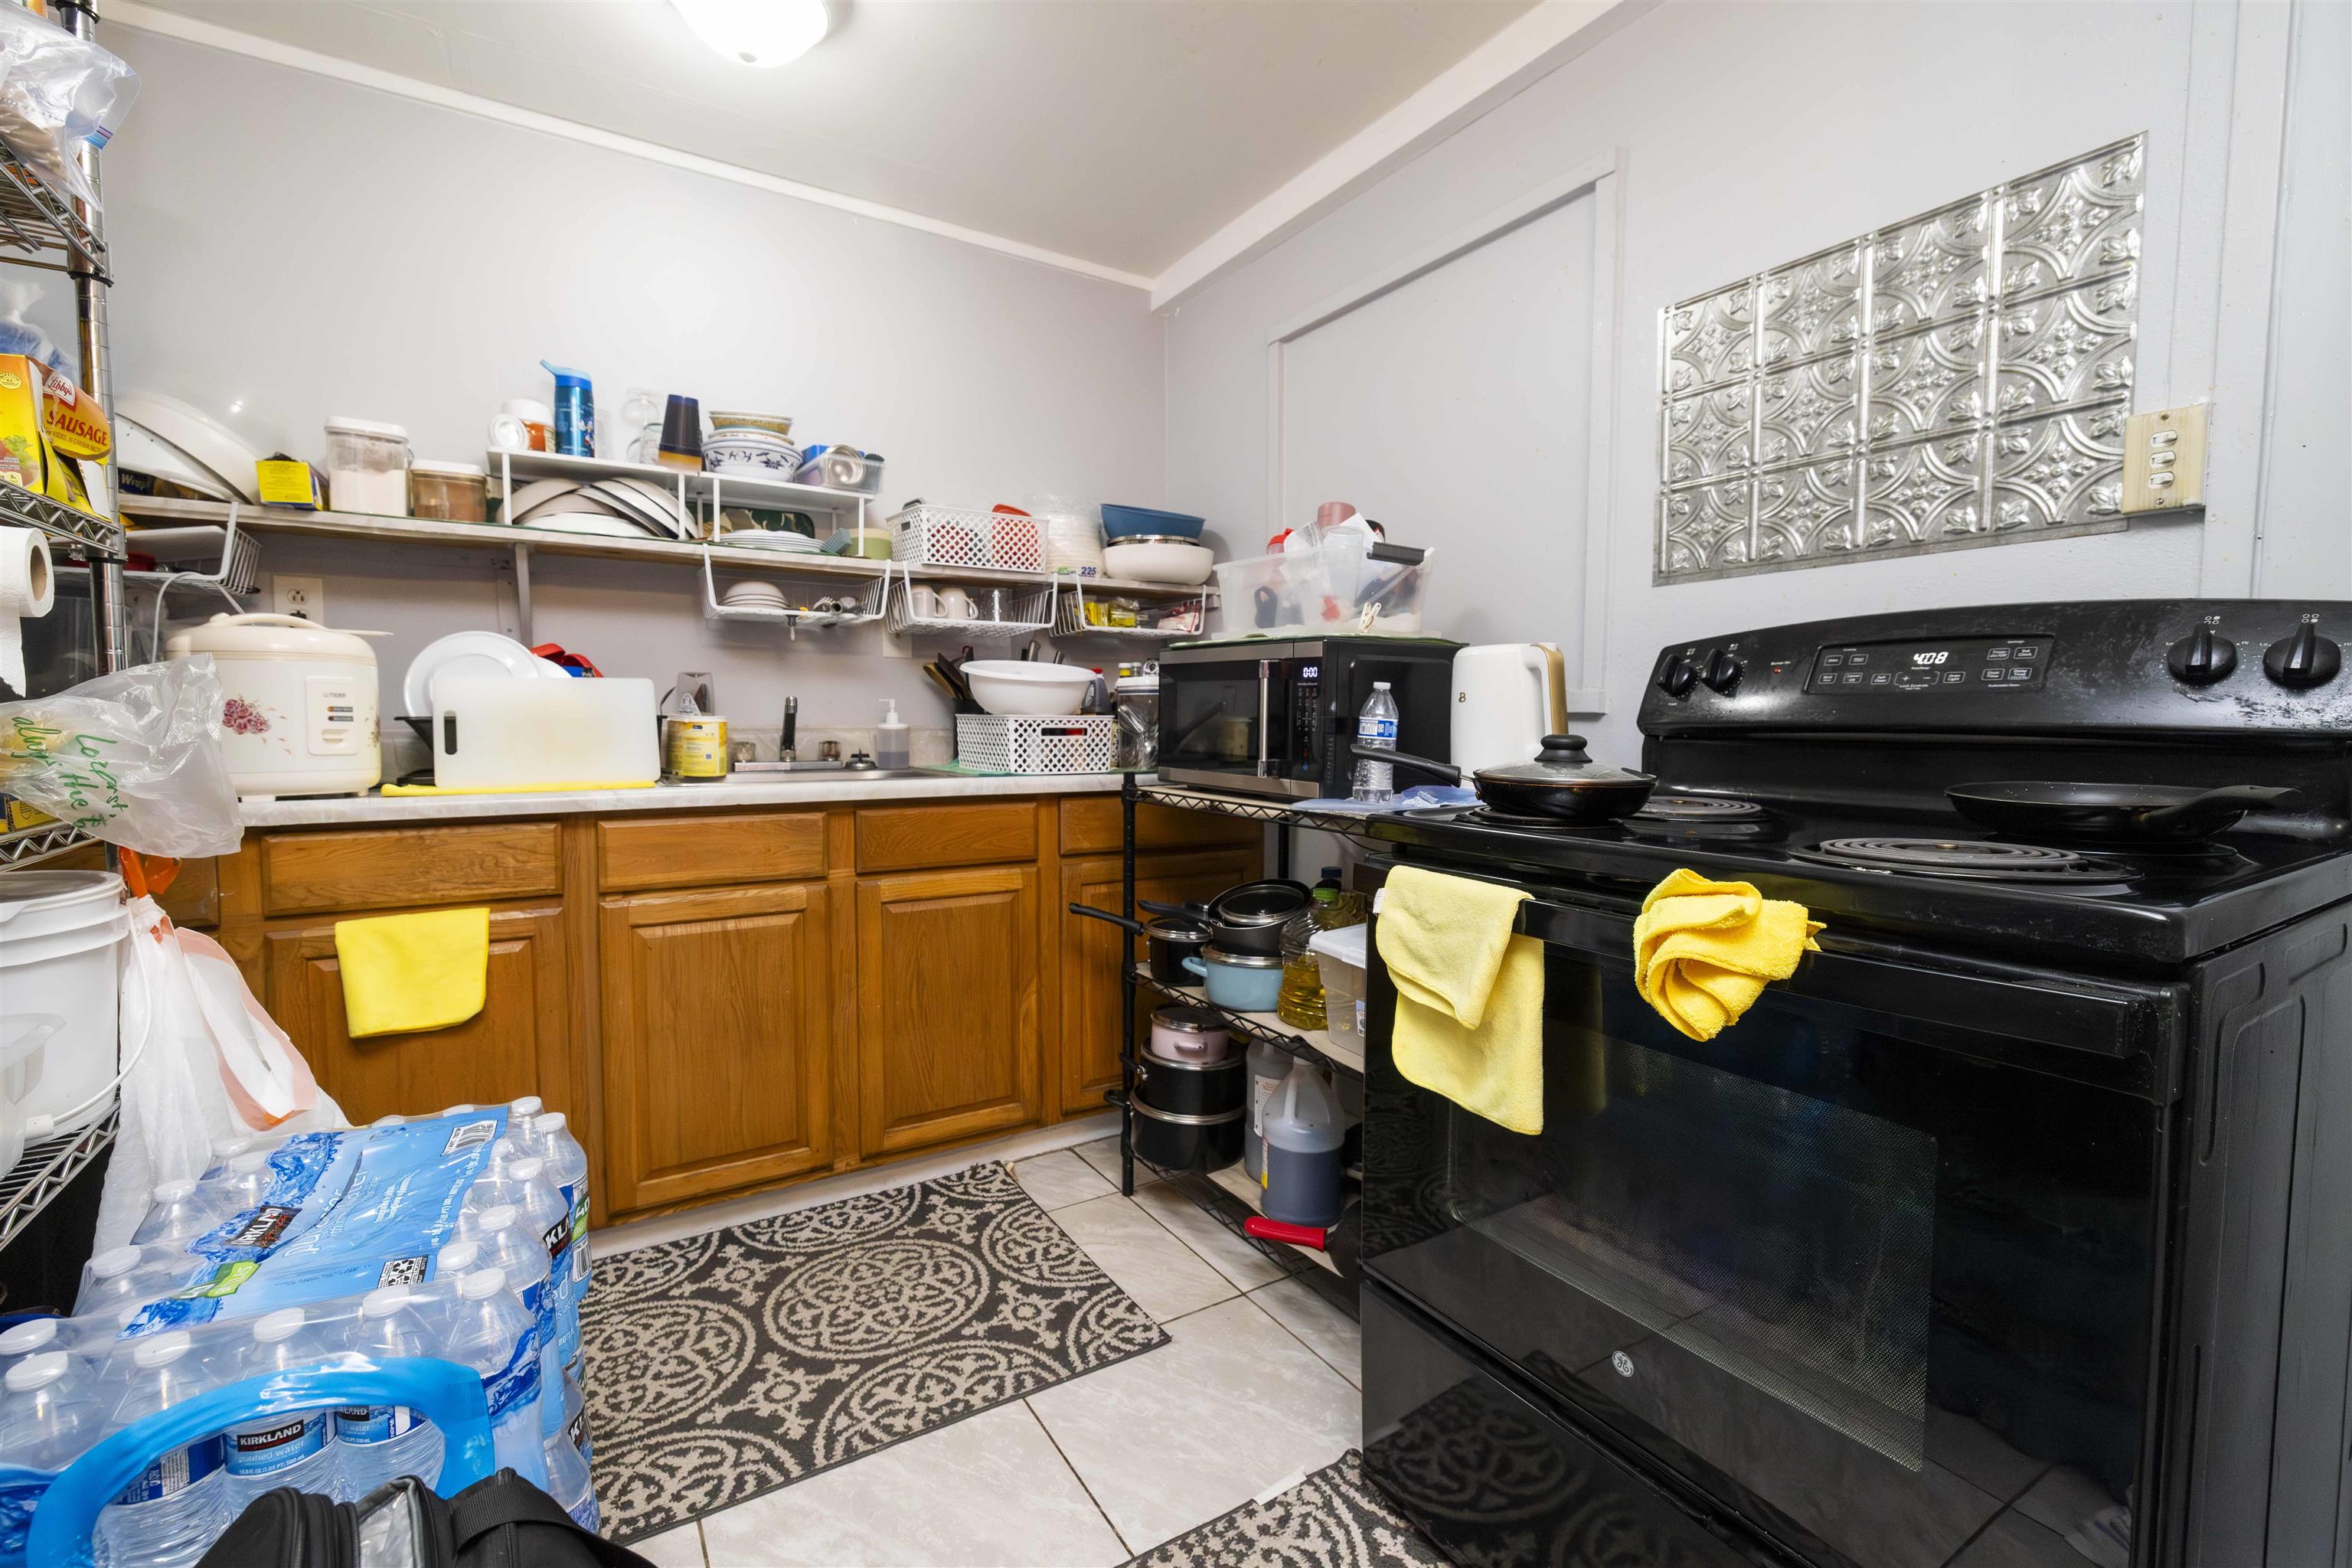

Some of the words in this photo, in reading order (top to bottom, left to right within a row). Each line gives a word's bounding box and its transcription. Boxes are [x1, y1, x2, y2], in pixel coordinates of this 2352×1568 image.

[47, 410, 107, 446] SAUSAGE
[1081, 567, 1096, 575] 225
[1459, 692, 1466, 702] B
[240, 1424, 302, 1446] KIRKLAND
[276, 1440, 305, 1457] water
